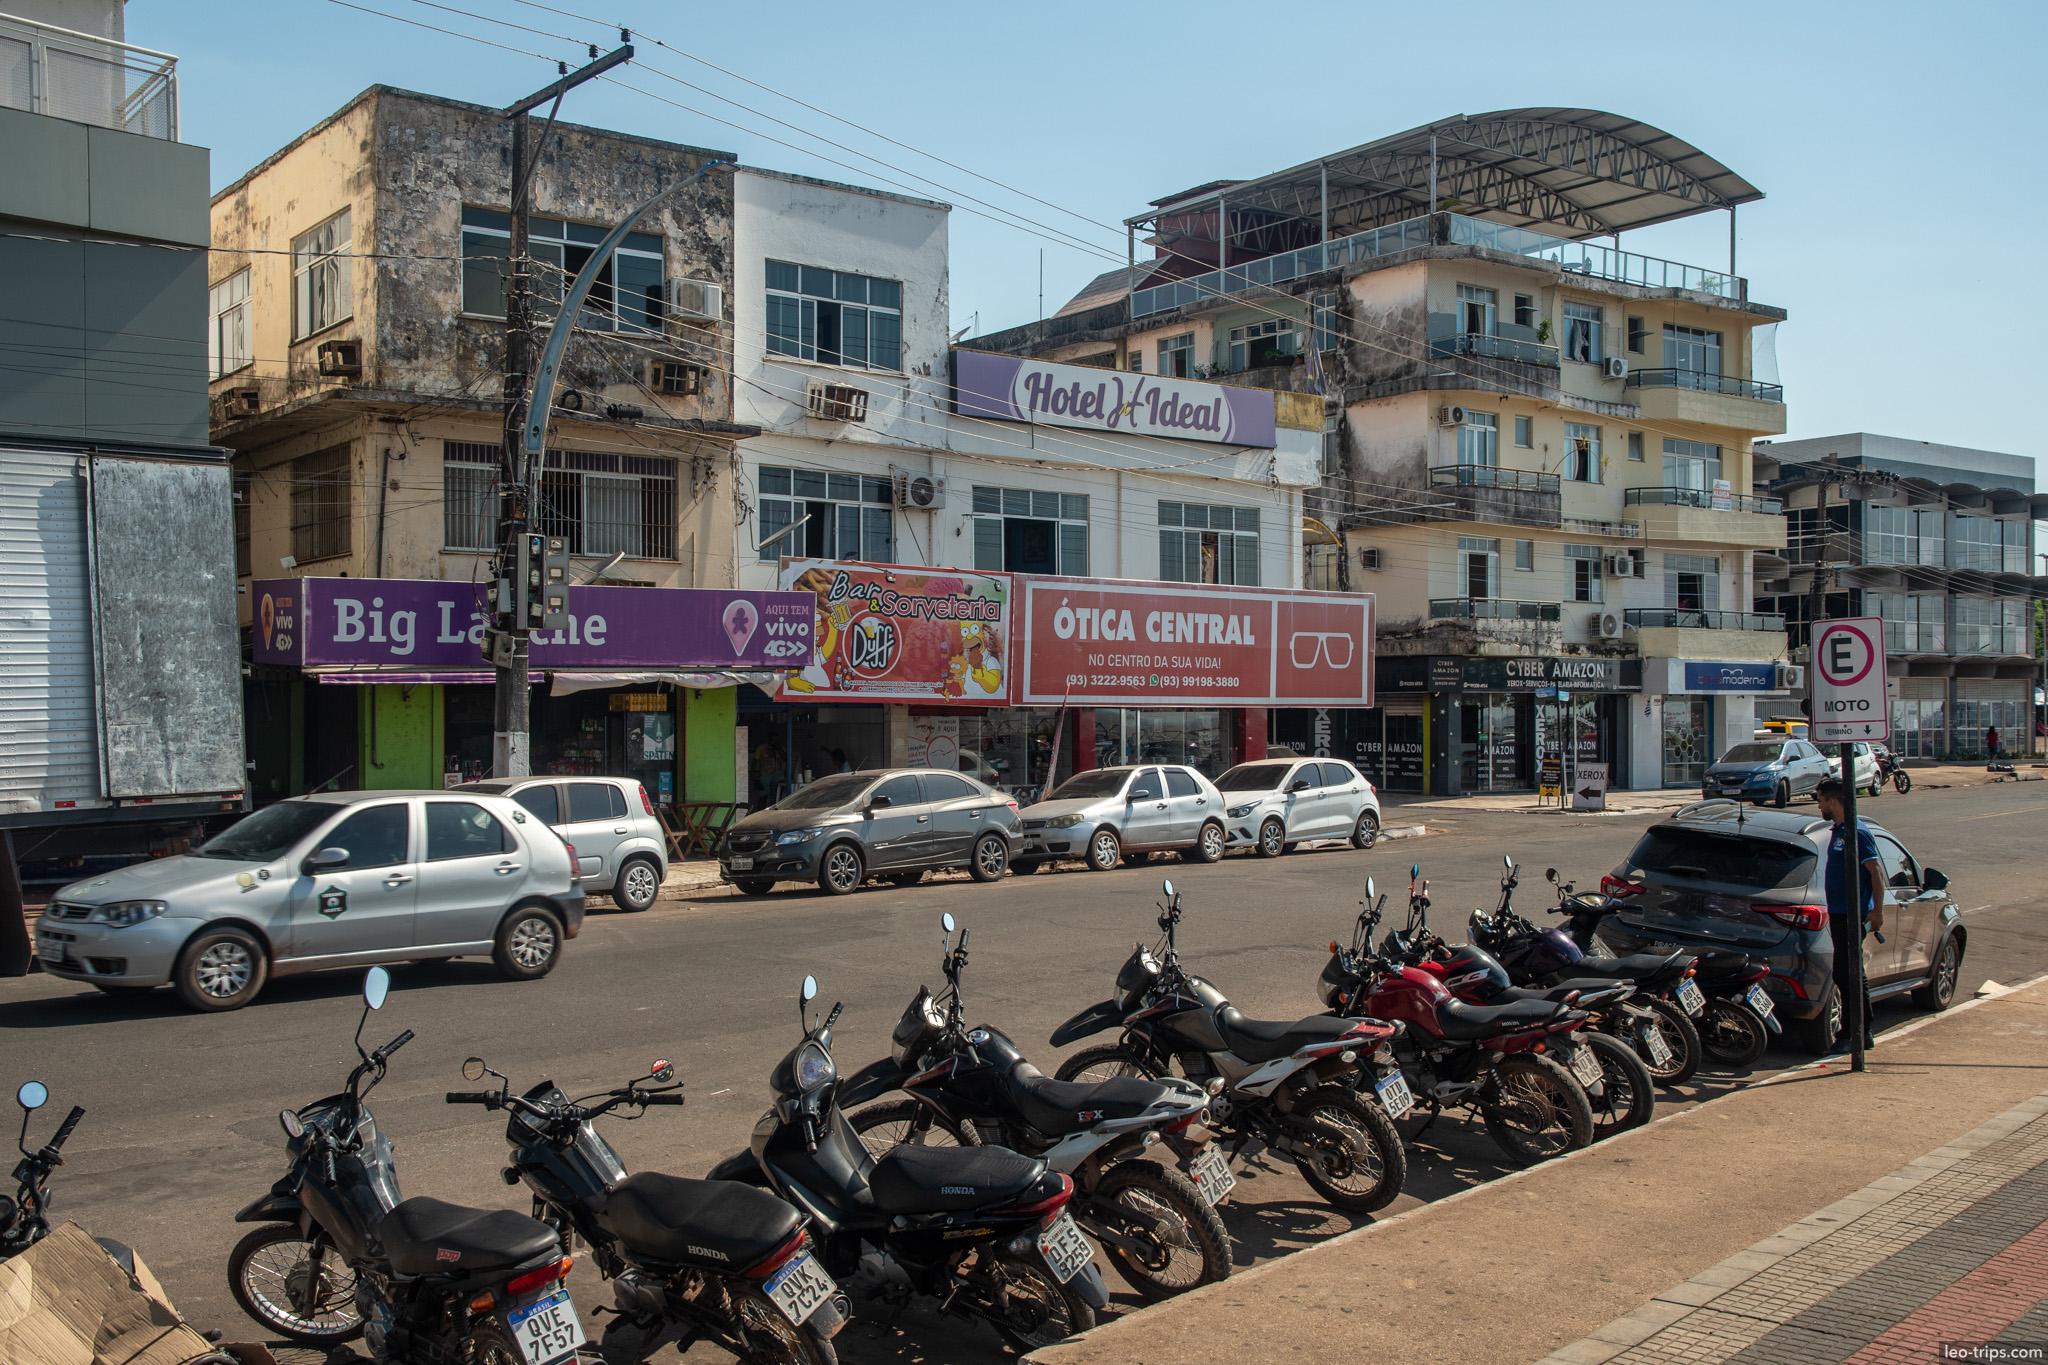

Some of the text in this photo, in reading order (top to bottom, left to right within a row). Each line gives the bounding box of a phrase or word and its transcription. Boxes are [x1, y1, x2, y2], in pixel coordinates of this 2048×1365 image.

[1024, 371, 1105, 420] Hotel
[1145, 387, 1222, 433] Ideal
[828, 570, 883, 601] Bar
[765, 604, 809, 616] AQUI TEM
[869, 590, 1001, 622] & Sorveteria
[275, 610, 293, 630] vivo
[333, 596, 417, 655] Big
[765, 617, 809, 637] vivo
[1053, 597, 1255, 646] ÓTICA CENTRAL
[852, 622, 896, 669] Duff
[1830, 637, 1854, 674] E
[1088, 653, 1221, 669] NO CENTRO DA SUA VIDA!
[1506, 660, 1605, 679] CYBER AMAZON
[1066, 674, 1240, 689] (93) 3222-9563 (93) 99198-3880
[1824, 699, 1870, 713] MOTO
[1825, 727, 1853, 736] TÉRMINO
[643, 750, 674, 760] SPATEN
[1356, 742, 1422, 754] CYBER AMAZON
[1577, 770, 1606, 781] XEROX
[941, 1186, 976, 1195] HONDA
[1203, 1170, 1233, 1203] 7405
[687, 1245, 730, 1262] HONDA
[1059, 1240, 1091, 1278] 8259
[778, 1263, 798, 1282] BRASIL
[780, 1265, 814, 1299] QVK
[787, 1277, 829, 1319] 7C24
[528, 1301, 553, 1317] BRASIL
[527, 1306, 566, 1338] QVE
[529, 1324, 575, 1361] 7F57
